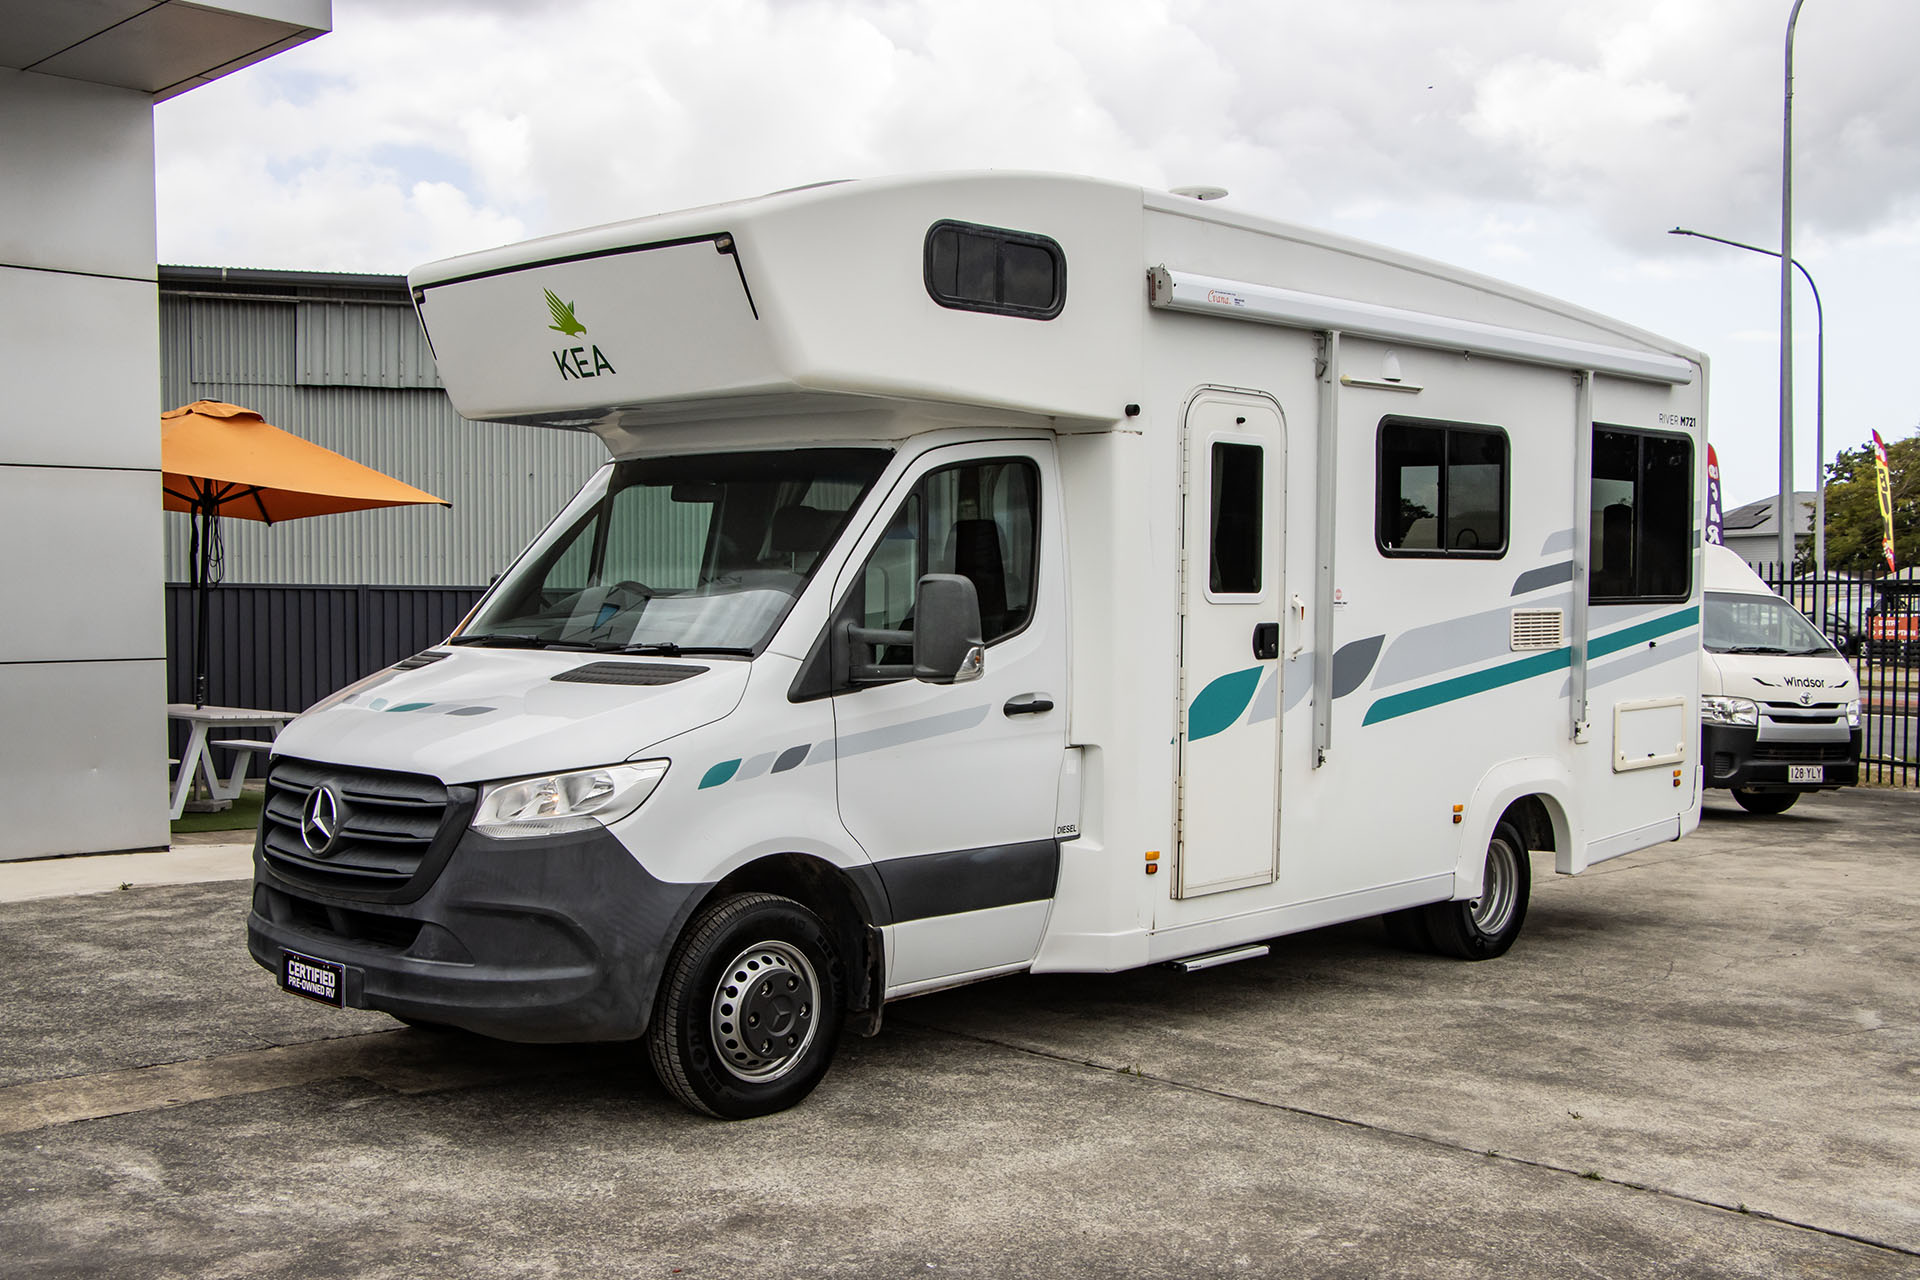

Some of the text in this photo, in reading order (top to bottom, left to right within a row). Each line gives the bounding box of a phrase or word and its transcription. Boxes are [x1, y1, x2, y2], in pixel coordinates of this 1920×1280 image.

[552, 344, 617, 381] KEA
[1658, 412, 1696, 427] RIVER M721
[1783, 676, 1825, 688] Windsor
[1057, 824, 1077, 834] DIESEL
[288, 960, 336, 988] CERTIFIED
[288, 975, 336, 998] PRE-OWNED RV
